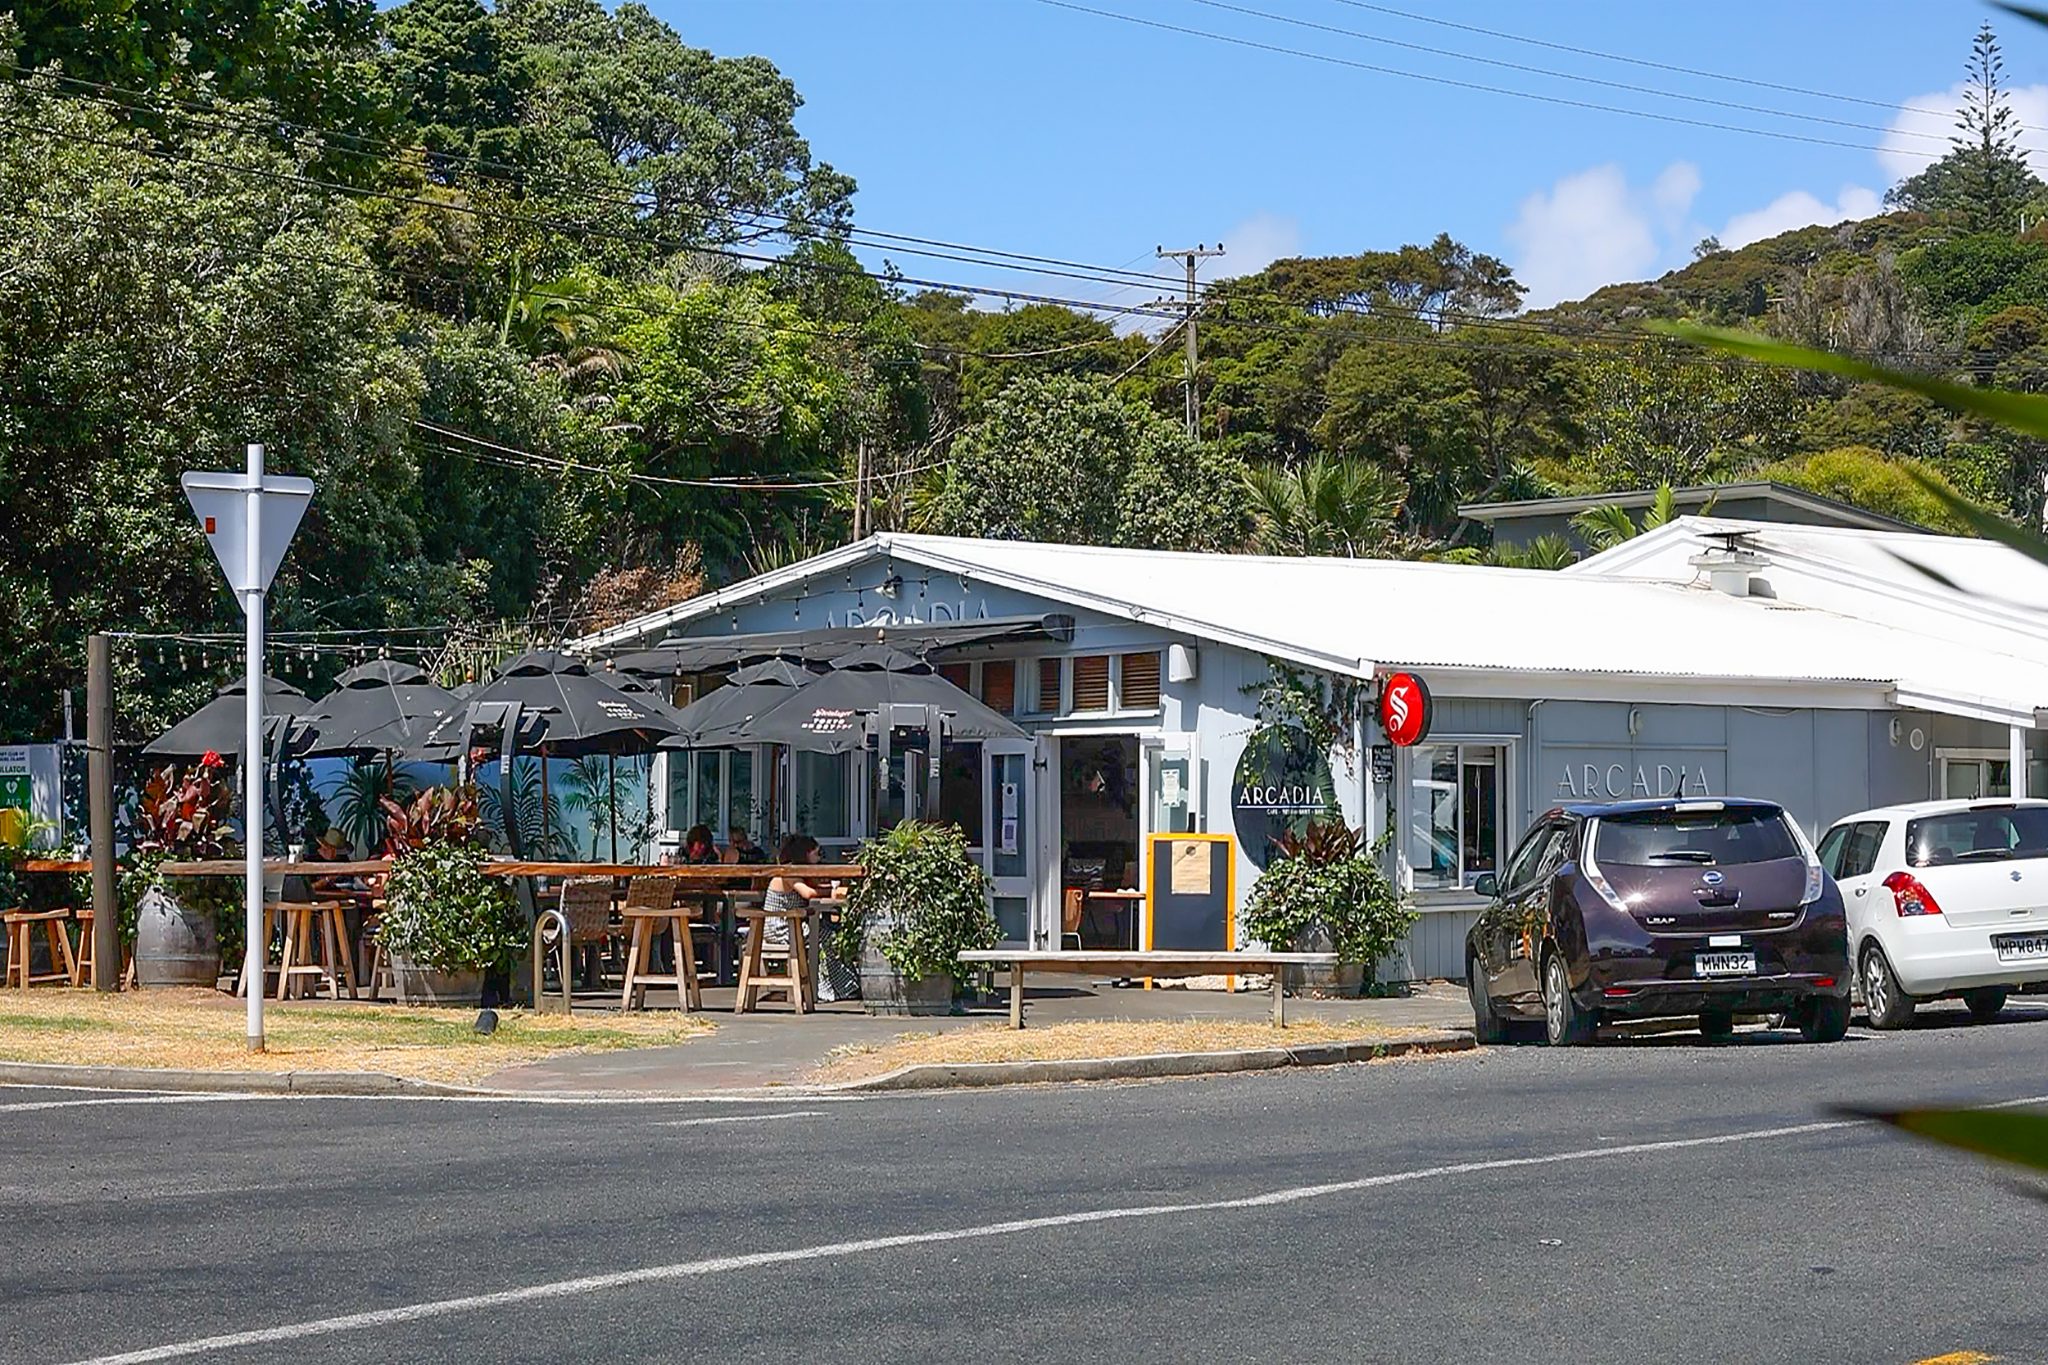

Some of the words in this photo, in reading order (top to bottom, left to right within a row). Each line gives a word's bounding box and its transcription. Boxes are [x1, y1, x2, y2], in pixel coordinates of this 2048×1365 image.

[1557, 763, 1710, 798] ARCADIA
[1240, 786, 1324, 804] ARCADIA
[1702, 955, 1749, 970] MWN32
